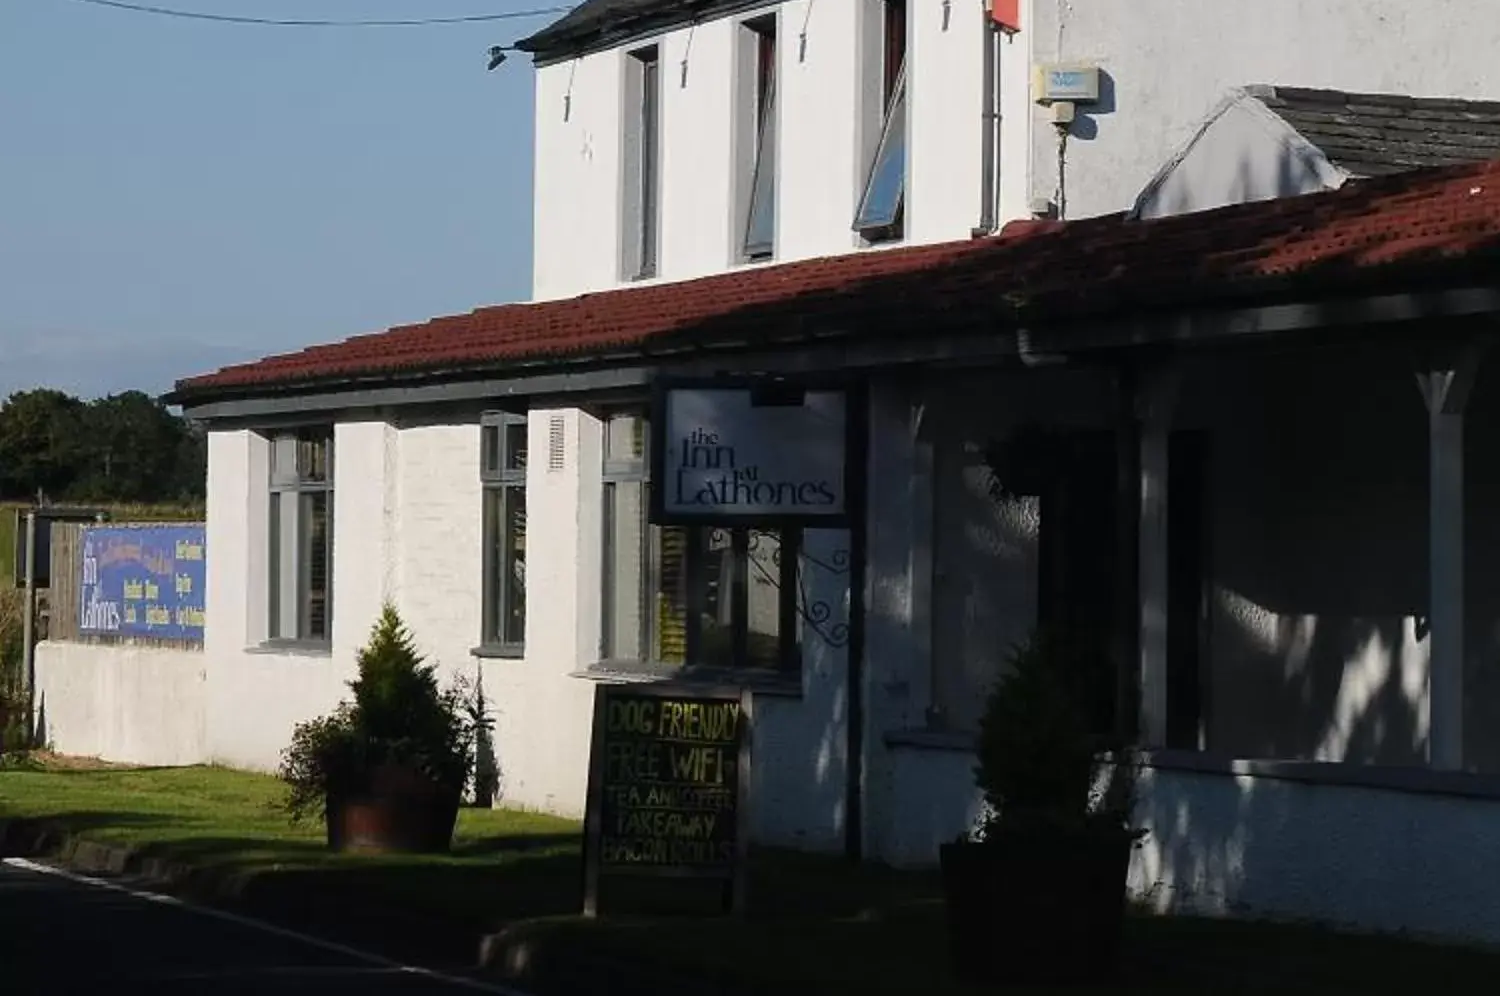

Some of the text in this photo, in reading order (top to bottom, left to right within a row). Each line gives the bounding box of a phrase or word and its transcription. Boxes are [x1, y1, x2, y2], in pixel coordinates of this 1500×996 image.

[691, 427, 719, 445] the
[681, 437, 735, 469] Inn
[674, 467, 836, 505] Lathones
[608, 699, 740, 741] DOG FRIENDLY
[608, 741, 660, 780] FREE
[605, 785, 641, 806] TEA
[616, 811, 716, 840] TAKEAWAY
